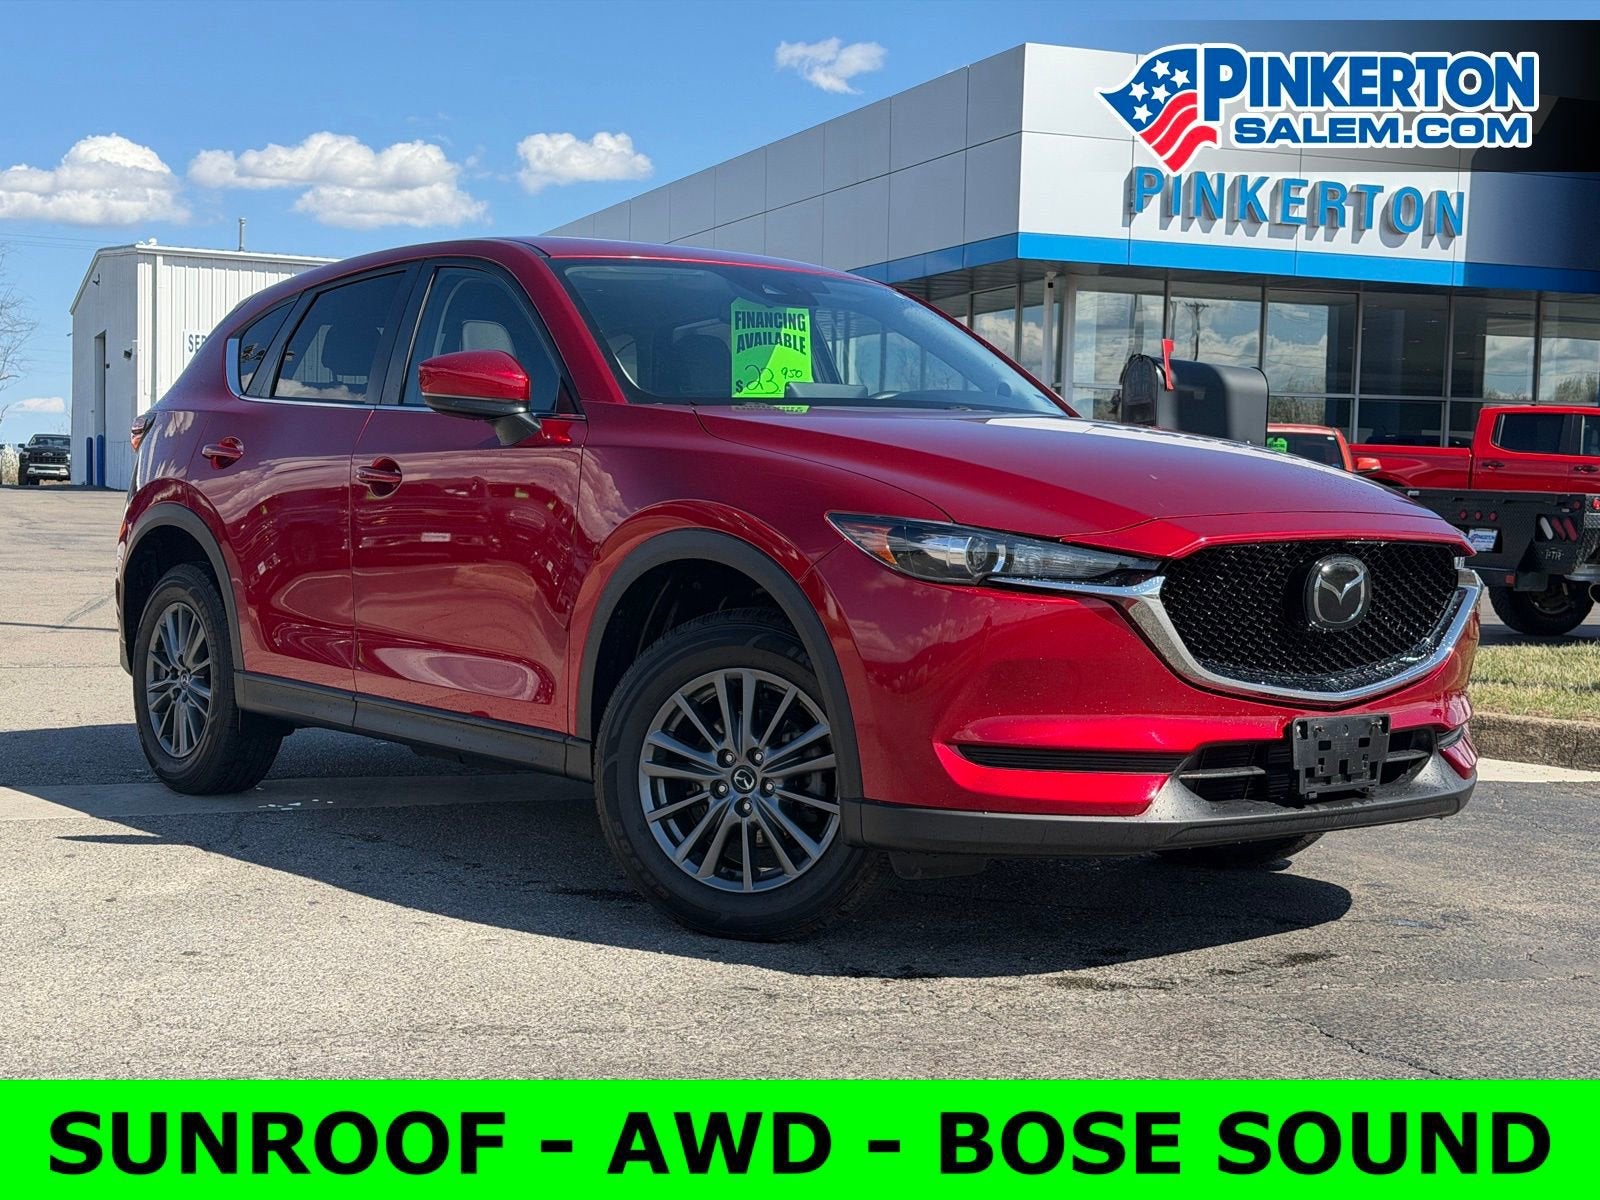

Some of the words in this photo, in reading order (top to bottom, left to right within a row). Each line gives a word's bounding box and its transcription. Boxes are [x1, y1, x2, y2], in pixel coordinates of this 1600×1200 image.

[1131, 166, 1465, 236] PINKERTON
[735, 311, 807, 333] FINANCING
[736, 332, 807, 355] AVAILABLE
